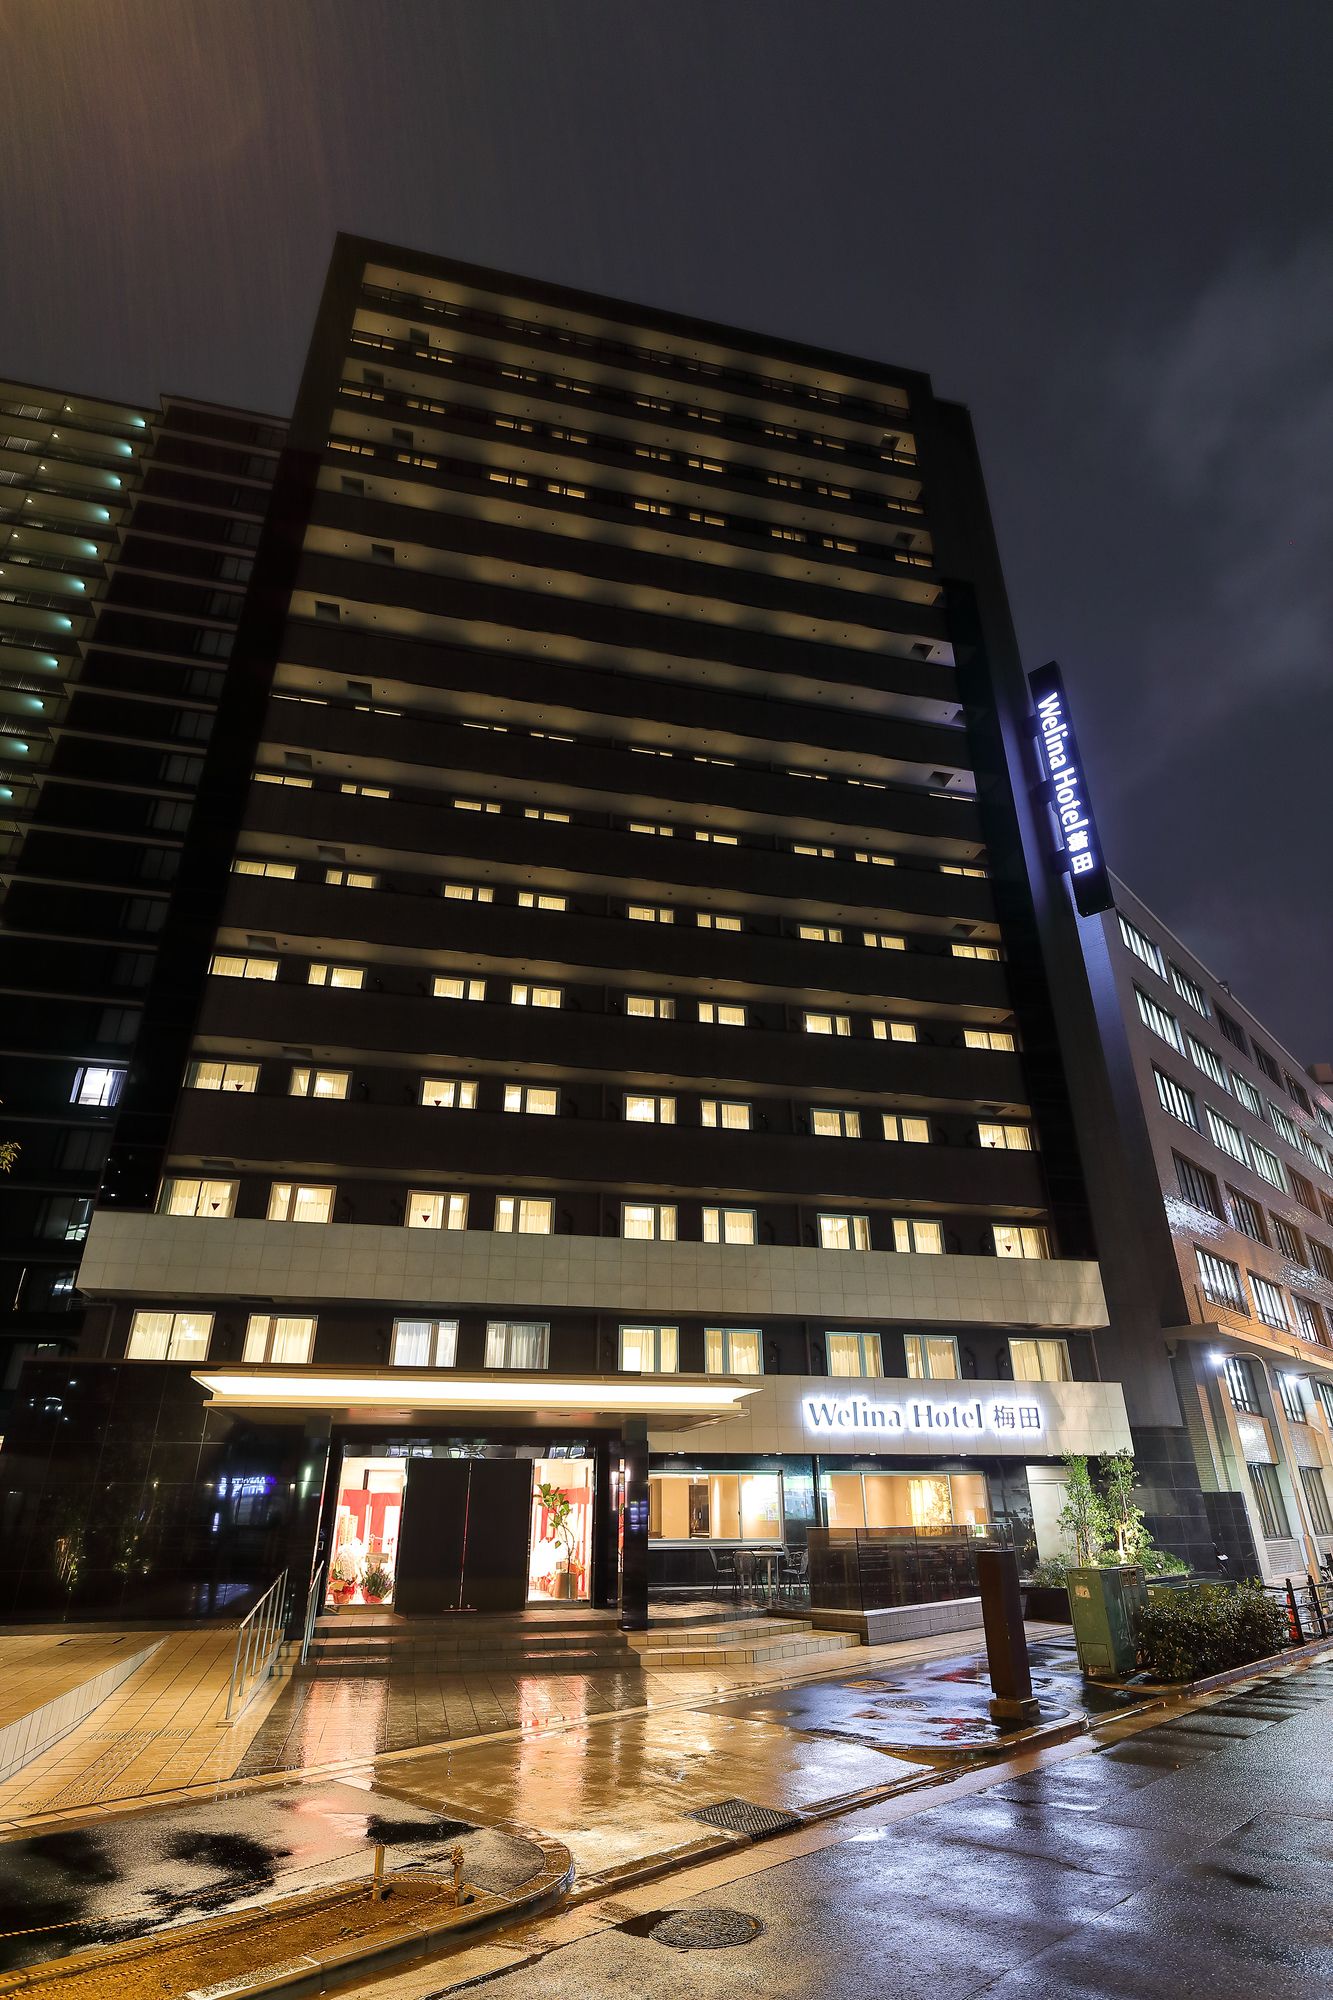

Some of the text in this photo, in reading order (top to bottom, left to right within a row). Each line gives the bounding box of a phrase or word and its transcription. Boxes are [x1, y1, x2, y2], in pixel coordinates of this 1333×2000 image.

[1038, 692, 1069, 771] Welina
[1053, 767, 1089, 832] Hotel
[808, 1401, 1042, 1430] Welina Hotel 梅田
